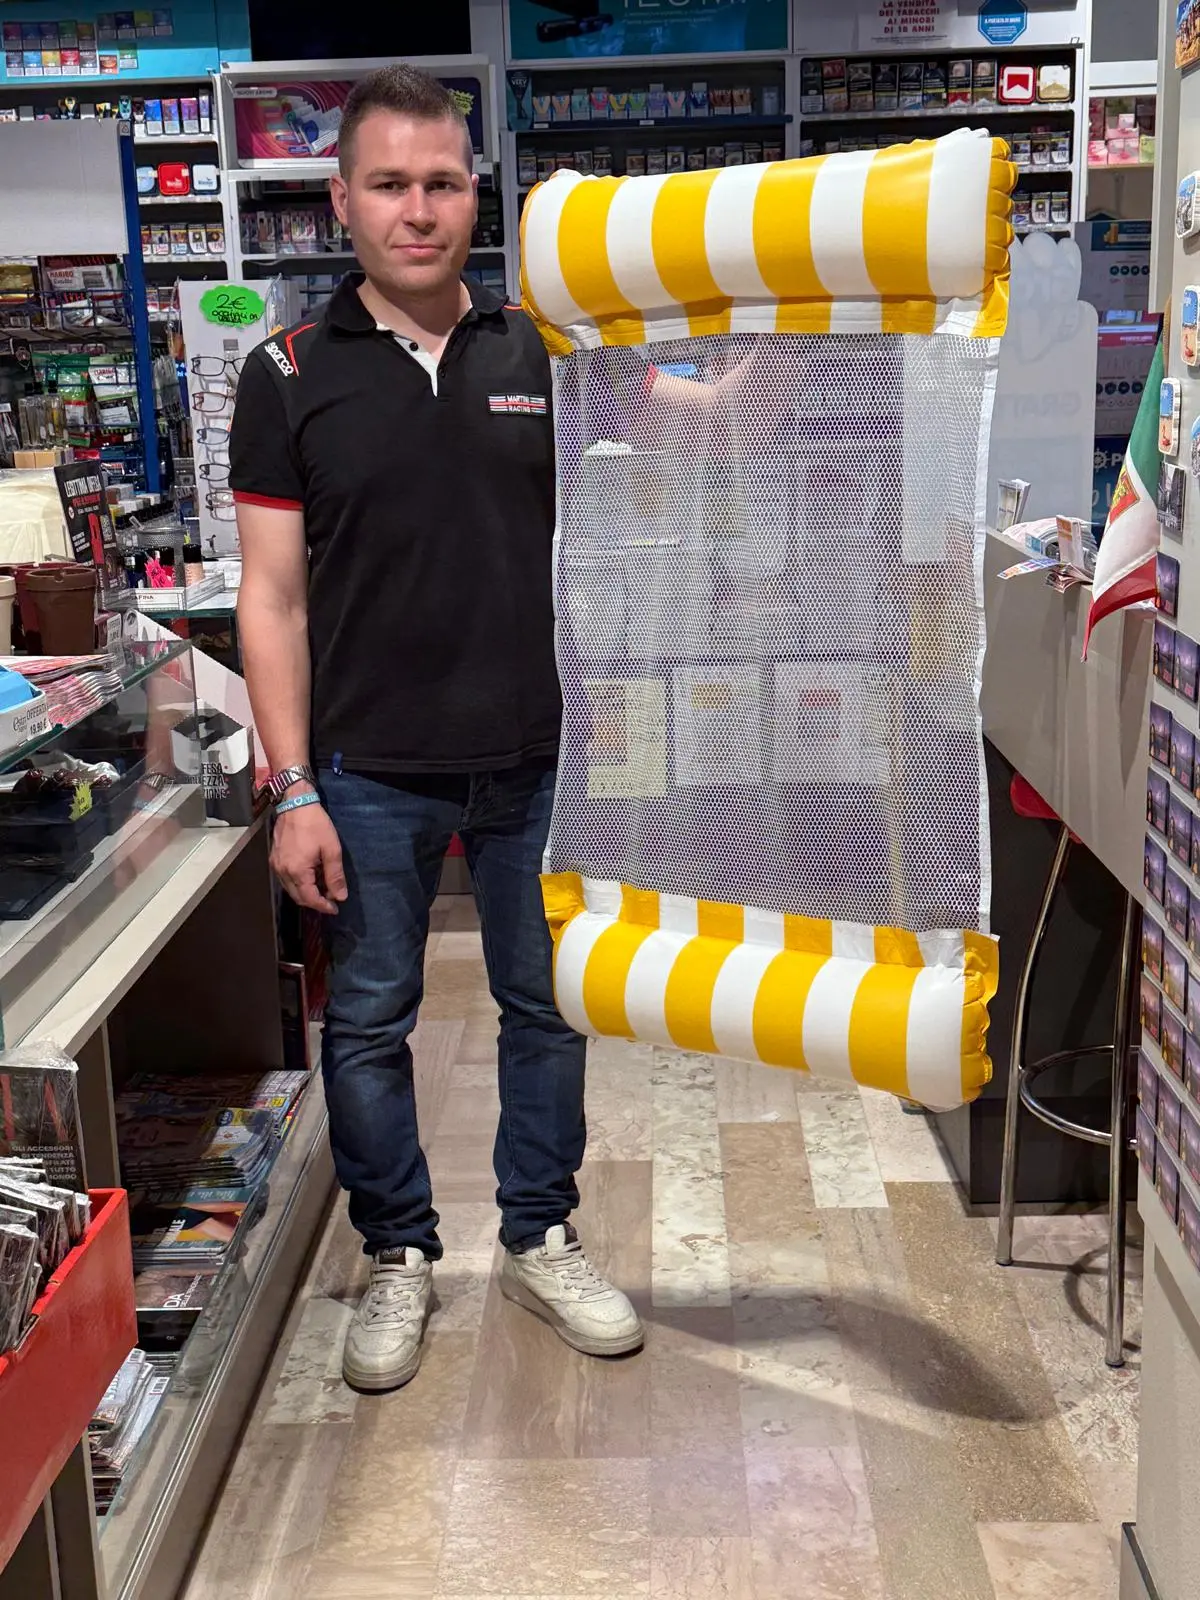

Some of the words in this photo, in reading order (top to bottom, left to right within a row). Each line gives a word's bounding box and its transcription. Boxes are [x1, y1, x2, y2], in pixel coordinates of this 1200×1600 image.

[879, 9, 893, 17] DEI
[896, 8, 940, 16] TABACCHI
[508, 405, 531, 413] RACING
